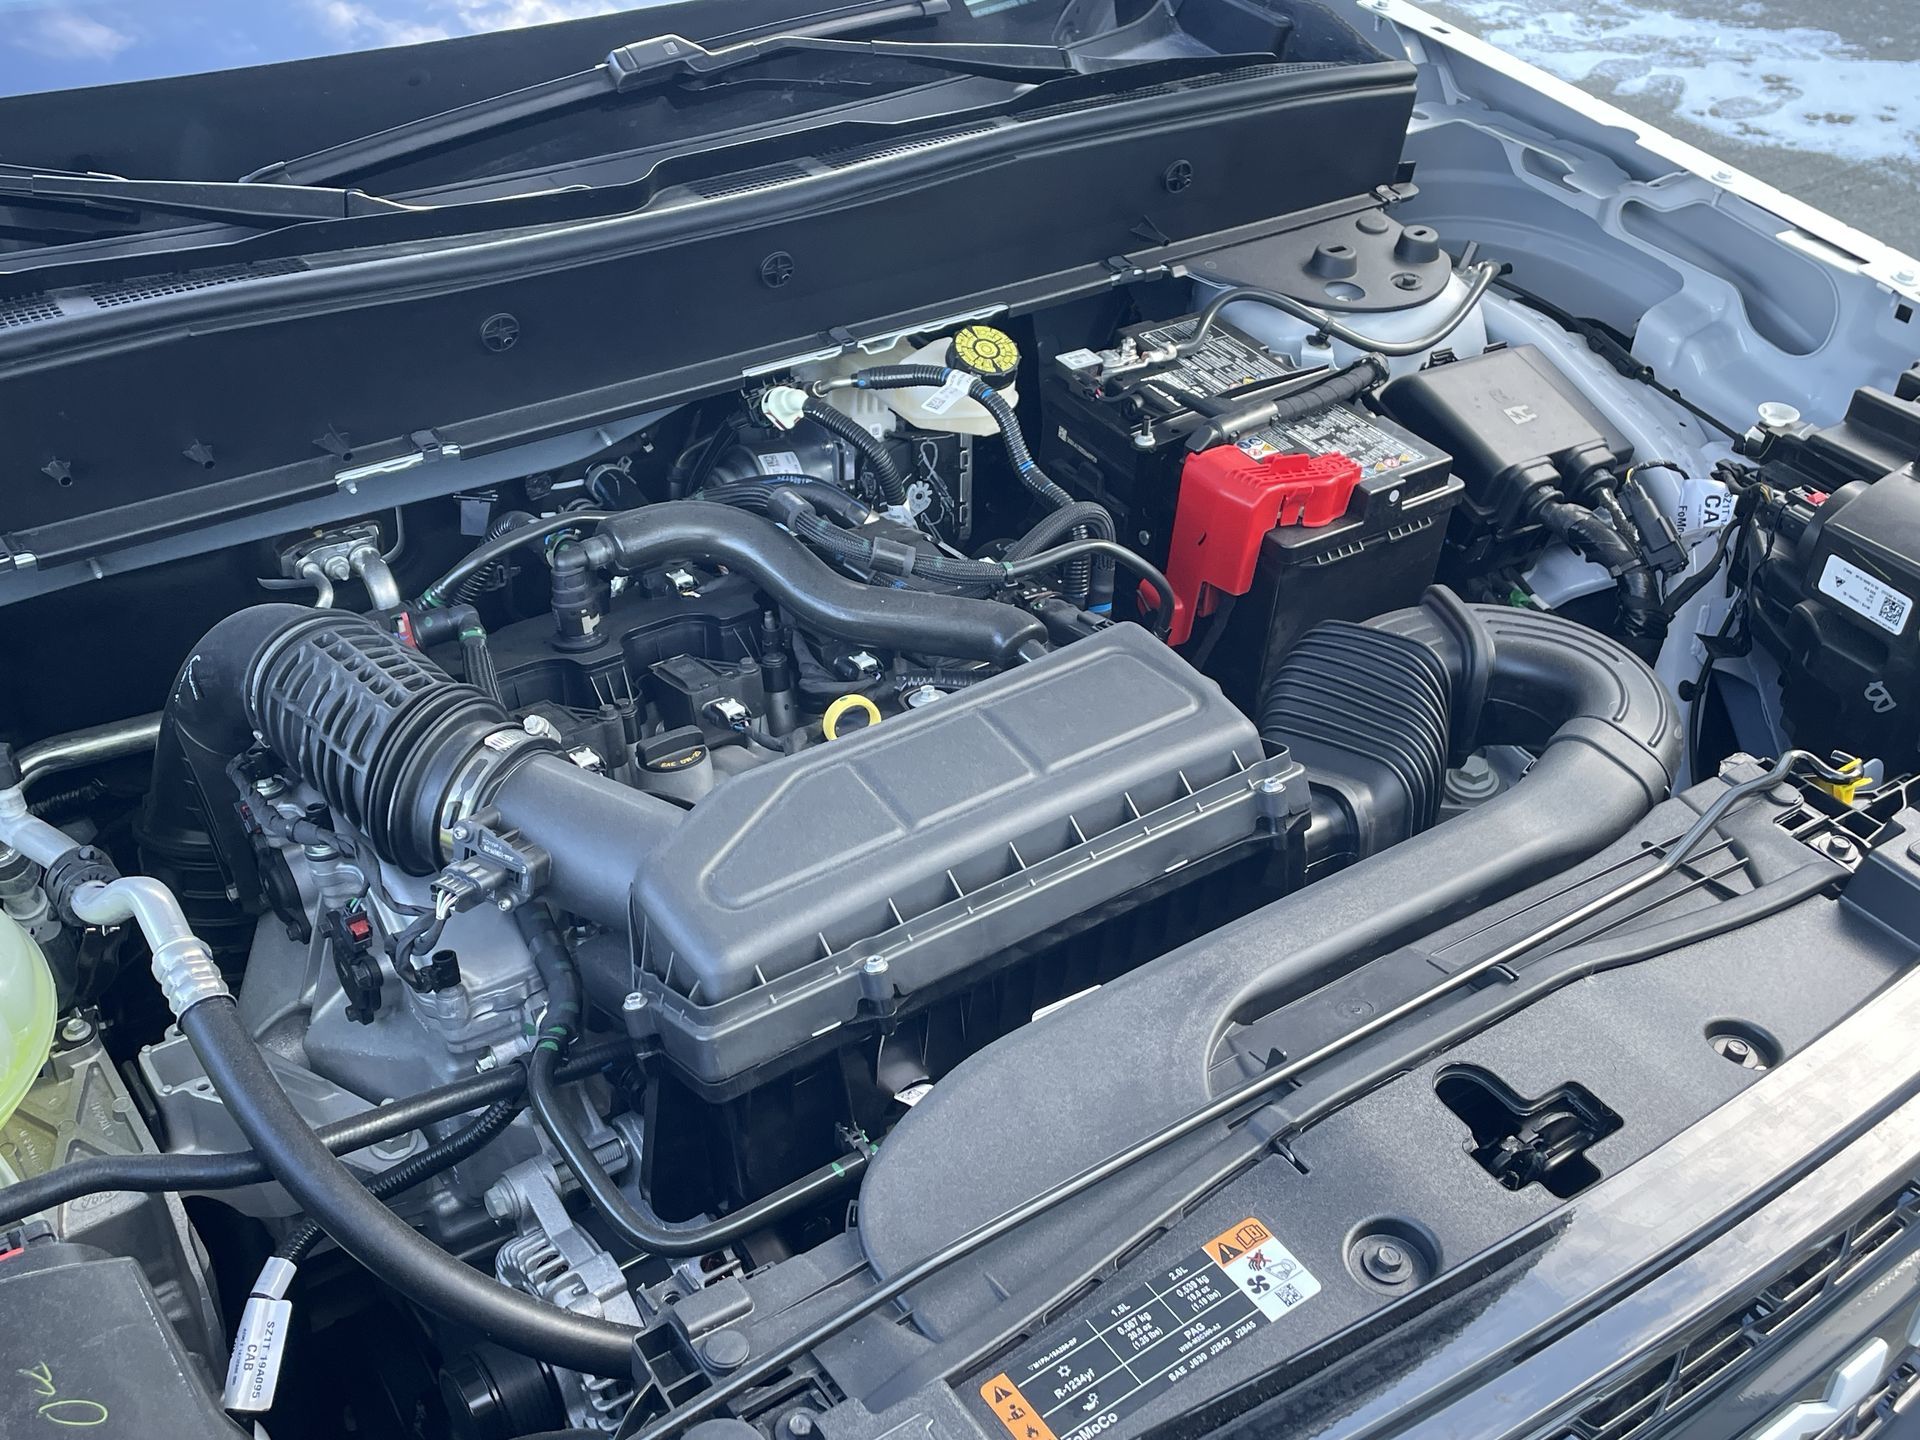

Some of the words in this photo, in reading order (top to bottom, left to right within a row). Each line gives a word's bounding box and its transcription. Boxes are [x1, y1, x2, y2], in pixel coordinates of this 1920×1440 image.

[1168, 1266, 1189, 1281] 2.0L
[1176, 1280, 1198, 1298] 0.539
[1195, 1274, 1210, 1285] kg
[1200, 1285, 1211, 1294] oz
[1206, 1288, 1222, 1302] lbs)
[1111, 1303, 1131, 1318] 1.5L
[1137, 1311, 1152, 1323] kg
[263, 1321, 275, 1350] SZ1T
[1127, 1327, 1143, 1341] 20.0
[1142, 1322, 1153, 1332] oz
[1147, 1326, 1164, 1340] lbs)
[1183, 1322, 1206, 1340] PAG
[243, 1344, 258, 1372] CAB
[1168, 1365, 1188, 1382] SAE
[1189, 1352, 1208, 1369] J639
[1209, 1336, 1232, 1355] J2842
[1234, 1320, 1256, 1339] J2845
[252, 1356, 268, 1399] 19A095
[1053, 1368, 1095, 1399] R-1234yf
